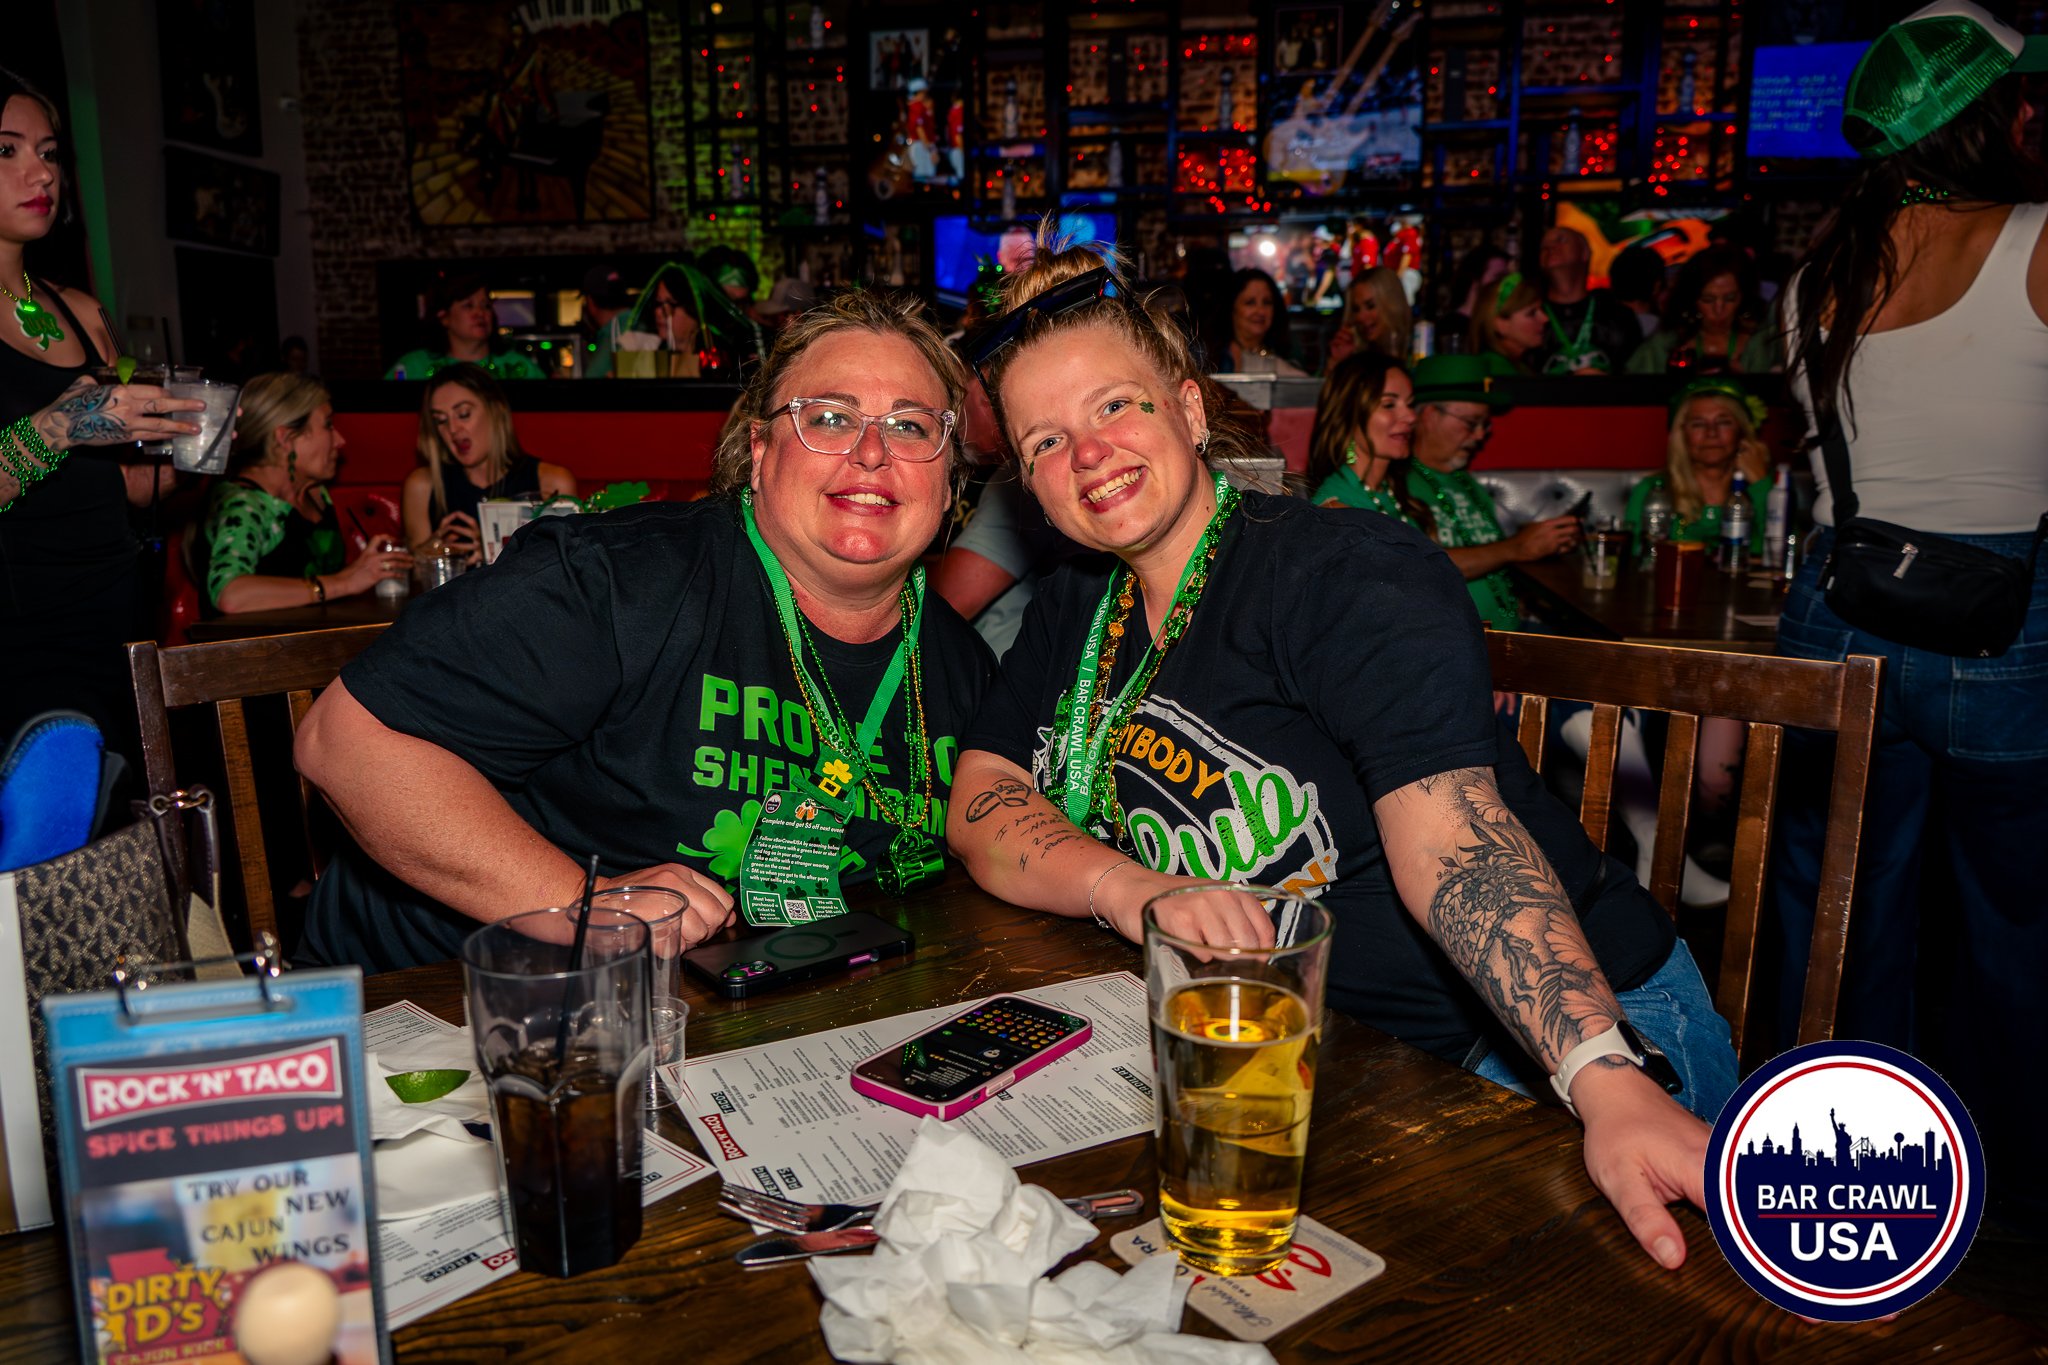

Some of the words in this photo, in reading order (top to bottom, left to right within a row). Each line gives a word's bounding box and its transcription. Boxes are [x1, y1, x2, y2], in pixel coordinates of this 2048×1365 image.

[1084, 634, 1099, 659] USA
[1075, 679, 1091, 704] BAR
[1070, 706, 1086, 757] CRAWL
[1070, 760, 1082, 791] USA
[1080, 763, 1094, 796] BAR
[762, 817, 785, 826] Complete
[794, 860, 813, 868] stranger
[812, 863, 830, 871] wearing
[90, 1072, 191, 1115] ROCK
[234, 1054, 328, 1092] TACO
[713, 1091, 736, 1113] TACOS
[86, 1127, 176, 1159] SPICE
[182, 1114, 287, 1147] THINGS
[294, 1104, 346, 1130] UP!
[703, 1115, 723, 1135] TACO
[187, 1178, 241, 1202] TRY
[252, 1168, 309, 1194] OUR
[778, 1168, 803, 1190] ACTS
[286, 1187, 351, 1217] NEW
[200, 1217, 285, 1245] CAJUN
[250, 1233, 351, 1266] WINGS
[106, 1267, 226, 1313] DIRTY
[133, 1301, 204, 1344] D'S
